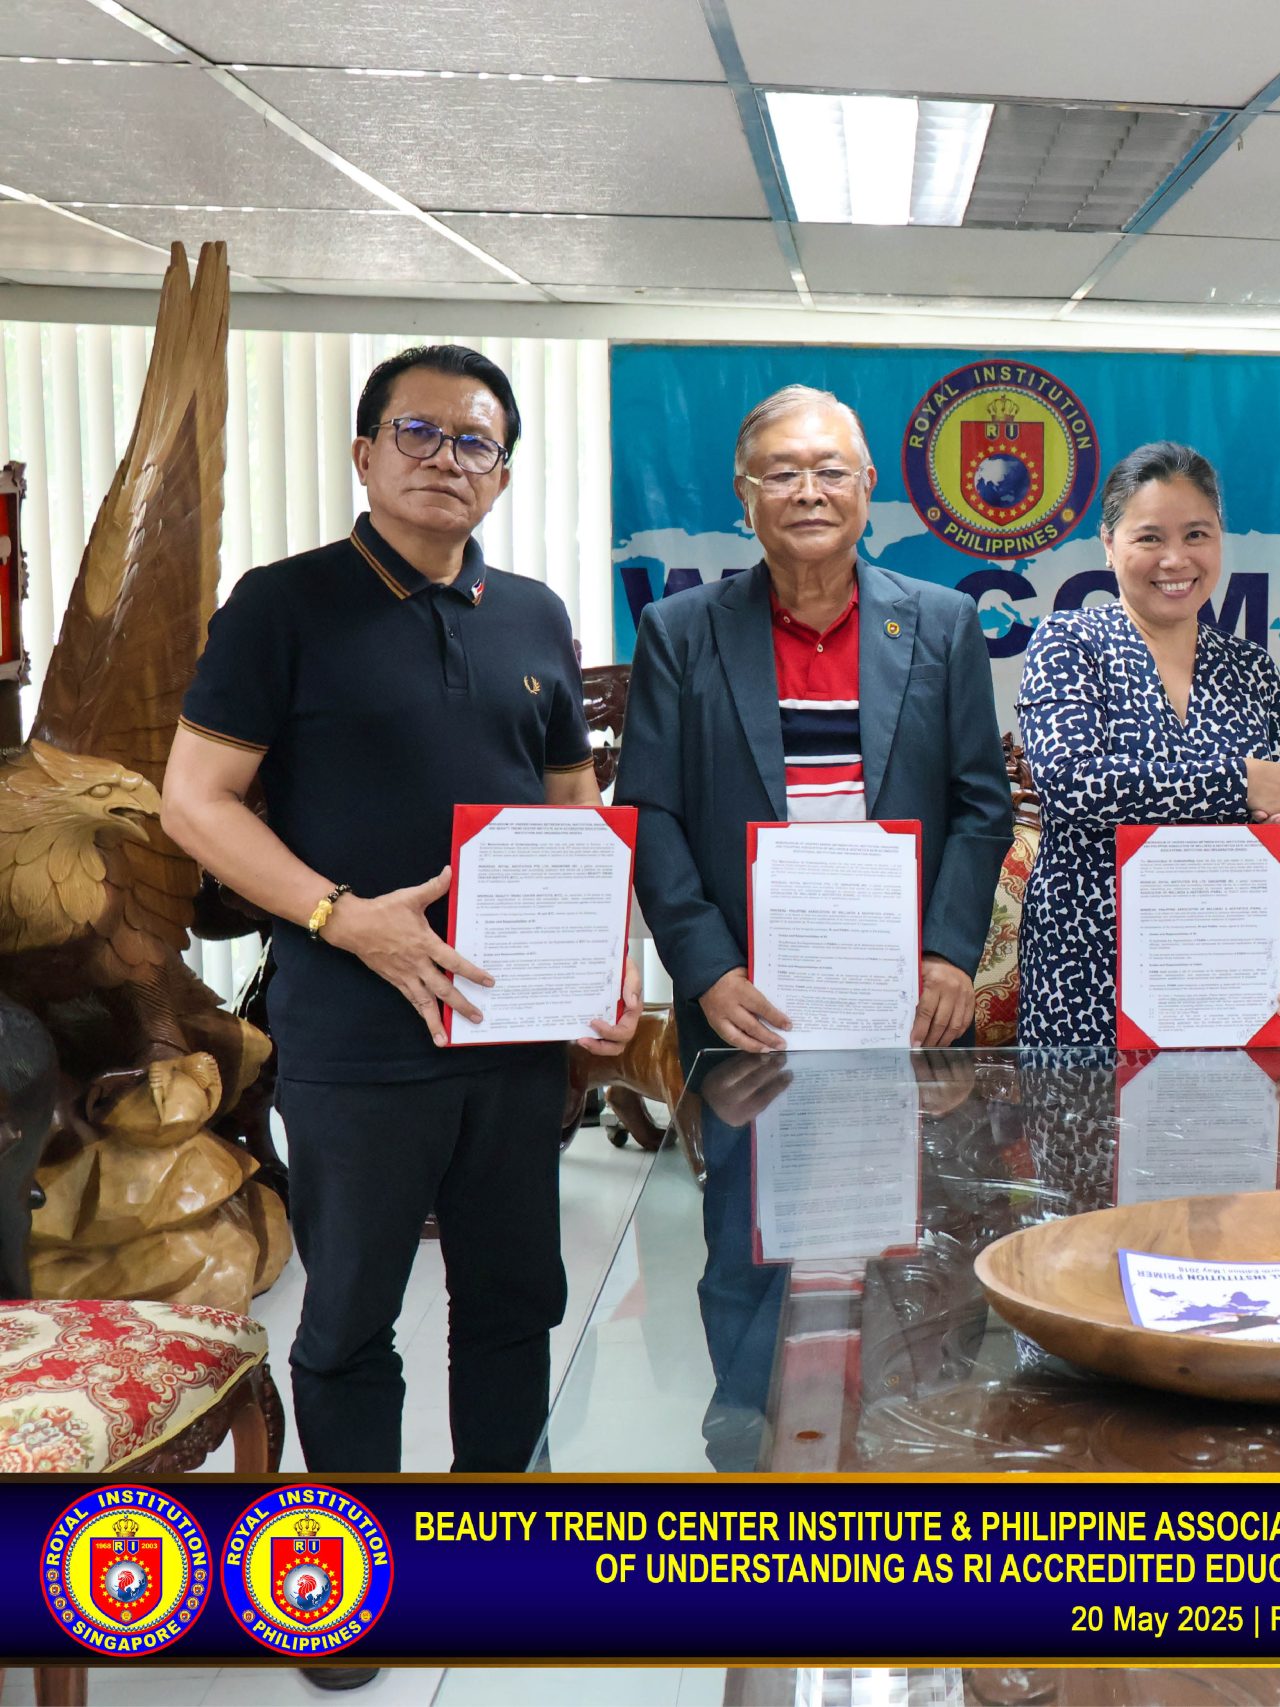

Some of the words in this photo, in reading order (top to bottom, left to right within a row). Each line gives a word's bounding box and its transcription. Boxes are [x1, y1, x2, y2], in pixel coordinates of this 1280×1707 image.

[908, 383, 960, 449] ROYAL
[973, 365, 1093, 450] INSTITUTION
[944, 523, 1059, 554] PHILIPPINES
[1136, 1270, 1184, 1281] PRIMER
[1186, 1272, 1267, 1281] INSTITUTION
